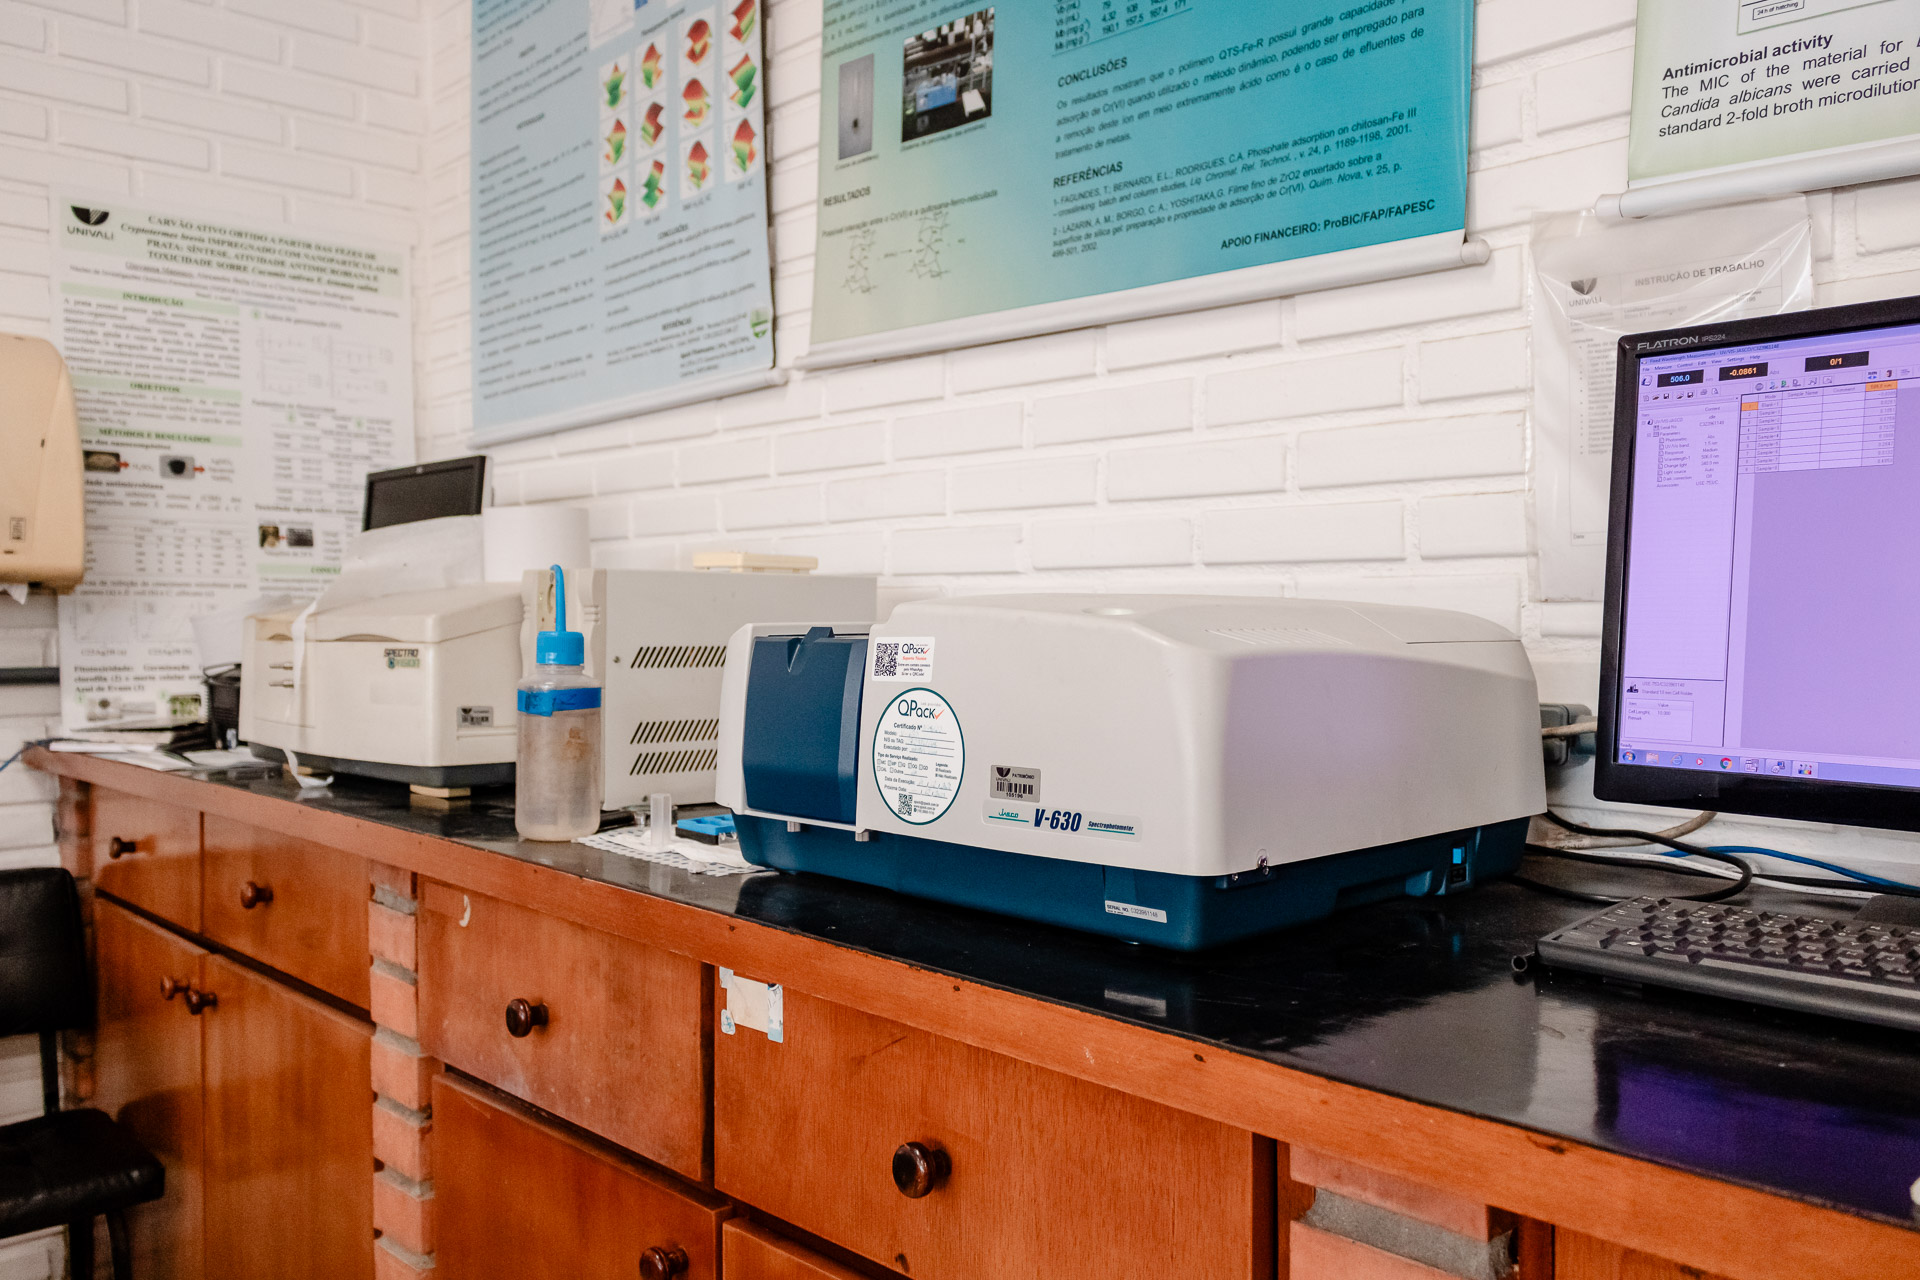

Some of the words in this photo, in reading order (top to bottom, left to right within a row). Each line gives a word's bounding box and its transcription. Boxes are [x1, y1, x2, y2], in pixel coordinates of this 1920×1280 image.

[1150, 71, 1164, 82] que
[1169, 68, 1174, 76] o
[1218, 38, 1264, 60] QTS-Fe-R
[1268, 28, 1297, 47] possui
[1301, 16, 1334, 36] grande
[1158, 79, 1191, 97] utilizado
[1193, 77, 1198, 86] o
[1204, 66, 1236, 83] método
[1281, 38, 1321, 60] podendo
[1323, 32, 1339, 46] ser
[1341, 15, 1398, 40] empregado
[1400, 6, 1425, 24] para
[1662, 47, 1767, 81] Antimicrobial
[1772, 34, 1833, 57] activity
[1138, 110, 1150, 120] em
[1153, 102, 1173, 116] meio
[1176, 85, 1236, 109] extremamente
[1239, 76, 1262, 92] ácido
[1266, 68, 1291, 83] como
[1294, 63, 1301, 73] é
[1304, 60, 1311, 71] o
[1315, 53, 1339, 68] caso
[1342, 46, 1356, 60] de
[1359, 33, 1406, 54] efluentes
[1410, 27, 1425, 39] de
[1661, 97, 1720, 118] Candida
[1729, 83, 1792, 105] albicans
[1802, 74, 1841, 91] were
[1852, 57, 1910, 80] carried
[1662, 86, 1689, 99] The
[1700, 75, 1730, 92] MIC
[1741, 68, 1756, 83] of
[1766, 64, 1790, 78] the
[1802, 45, 1867, 71] material
[1880, 40, 1903, 55] for
[1247, 140, 1290, 158] Phosphate
[1291, 128, 1335, 147] adsorption
[1338, 126, 1349, 136] on
[1351, 112, 1404, 132] chitosan-Fe
[1659, 114, 1722, 137] standard
[1726, 105, 1768, 125] 2-fold
[1773, 98, 1813, 116] broth
[1307, 145, 1322, 157] 24,
[1335, 130, 1384, 151] 1189-1198,
[1386, 124, 1413, 139] 2001.
[1053, 161, 1123, 189] REFERÊNCIAS
[1173, 205, 1216, 222] propriedade
[1218, 200, 1227, 210] de
[1229, 191, 1265, 208] adsorção
[1266, 188, 1277, 198] de
[1309, 176, 1334, 190] Quim.
[1337, 169, 1364, 184] Nova,
[1376, 162, 1391, 175] 25,
[1228, 182, 1249, 196] Filme
[1251, 178, 1266, 191] fino
[1267, 176, 1278, 186] de
[1303, 160, 1346, 178] enxertado
[1347, 154, 1373, 168] sobre
[67, 225, 114, 240] UNIVALI
[1220, 233, 1252, 250] APOIO
[1254, 221, 1321, 244] FINANCEIRO:
[1324, 199, 1436, 231] ProBIC/FAP/FAPESC
[1634, 271, 1691, 287] INSTRUÇÃO
[1692, 268, 1707, 278] DE
[1709, 259, 1765, 276] TRABALHO
[1637, 336, 1699, 351] FLATRON
[1829, 358, 1842, 366] 0/1
[902, 643, 924, 654] QPack
[898, 699, 936, 719] QPack
[1034, 808, 1082, 832] V-630
[1088, 820, 1134, 832] Spectrophotometer
